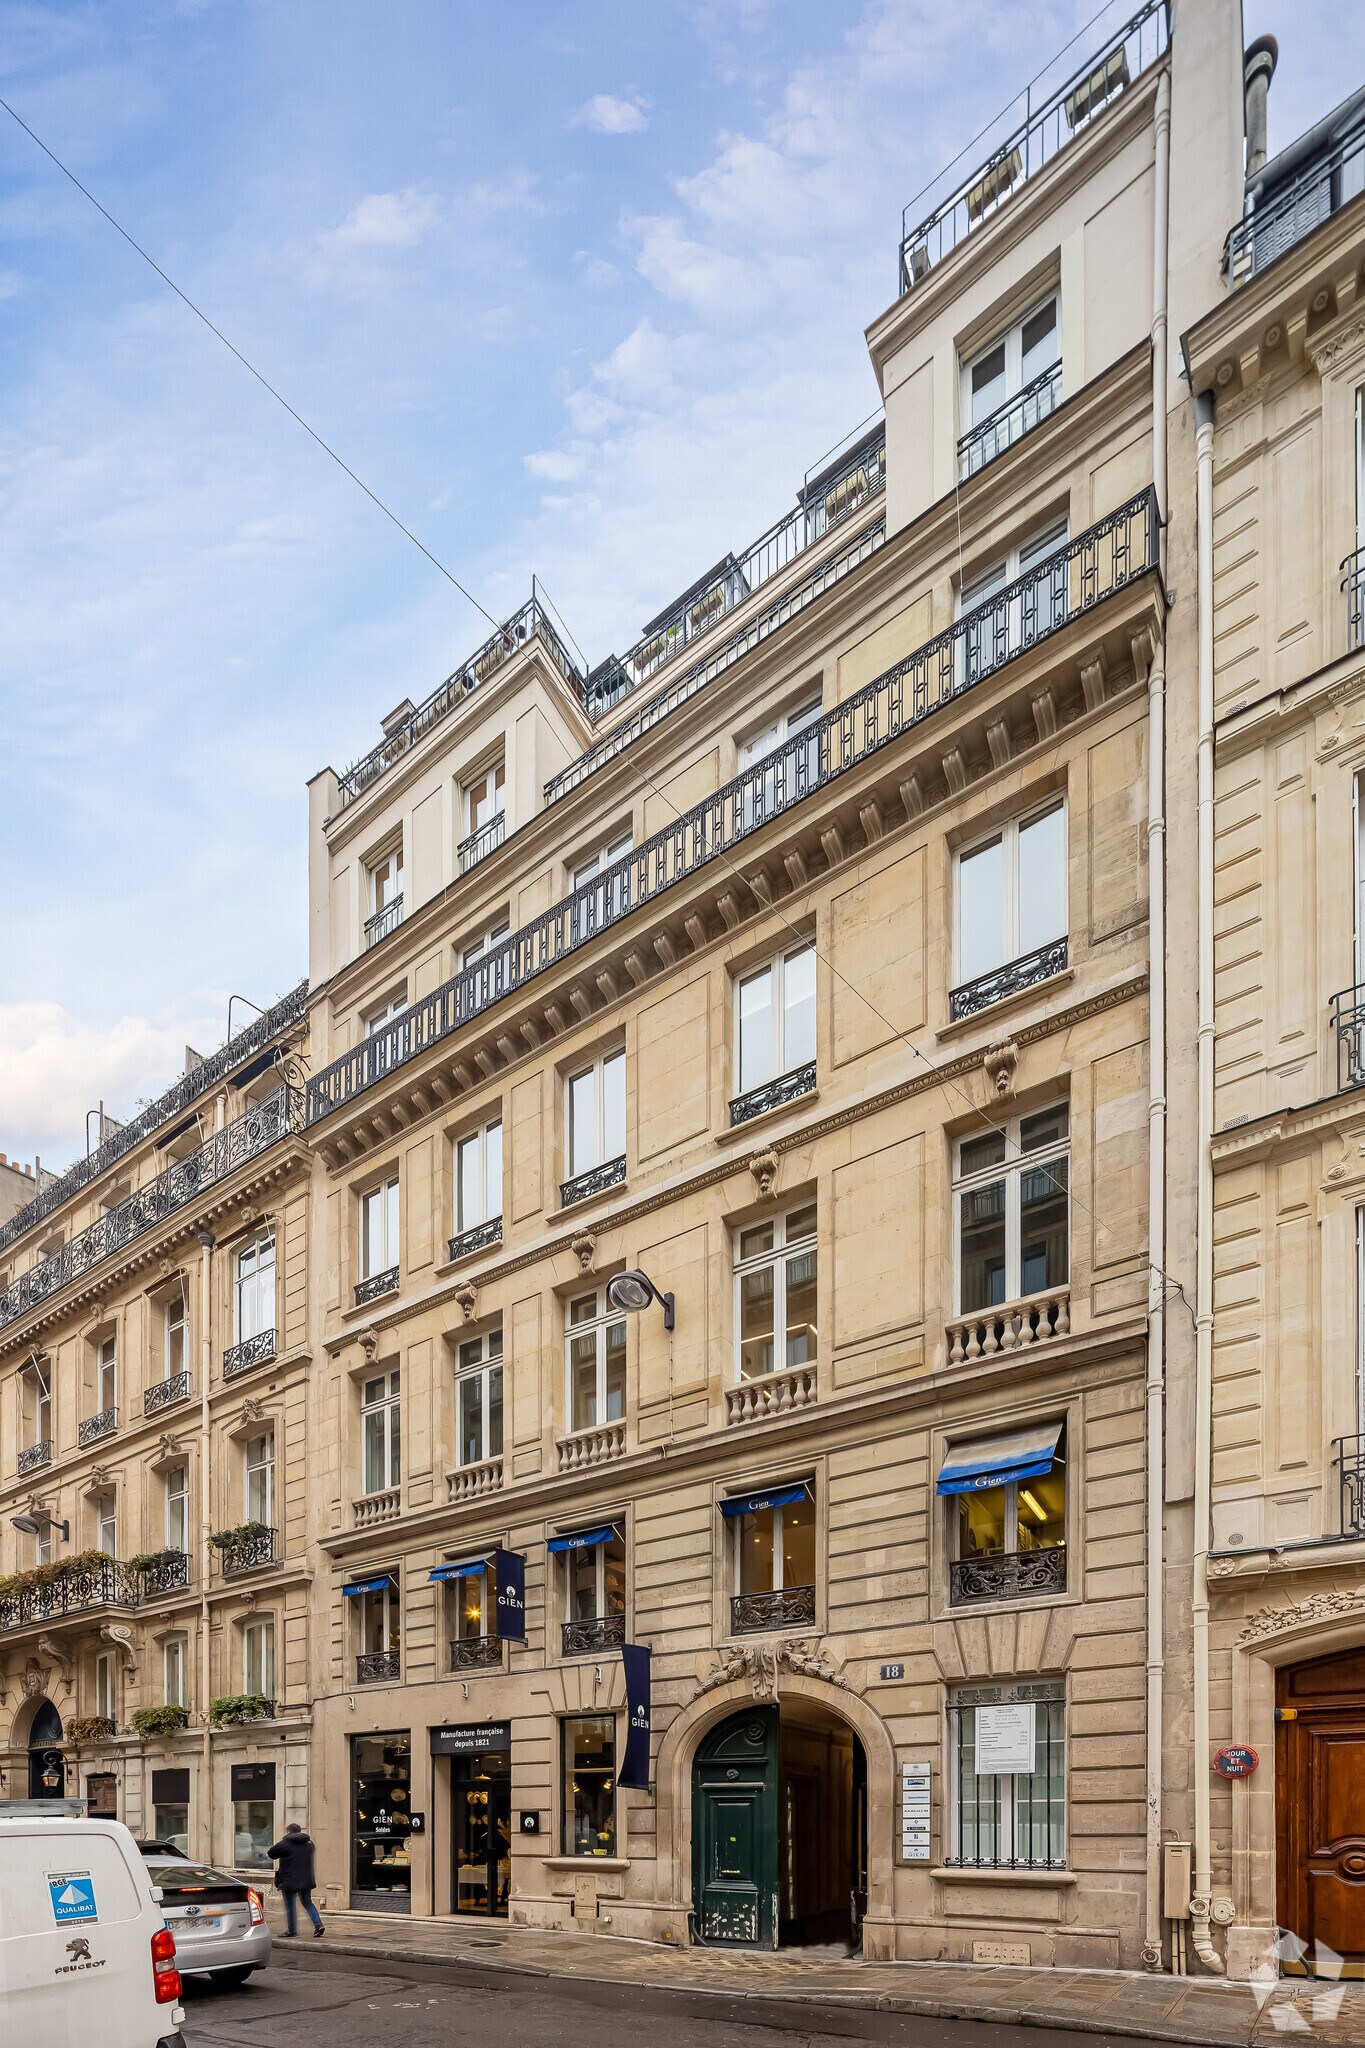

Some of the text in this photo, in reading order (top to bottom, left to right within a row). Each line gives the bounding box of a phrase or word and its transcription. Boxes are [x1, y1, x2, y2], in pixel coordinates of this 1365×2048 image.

[975, 1476, 1002, 1487] Gien
[749, 1499, 769, 1510] Gien
[498, 1596, 523, 1609] GIEN
[886, 1665, 899, 1678] 18
[631, 1717, 649, 1729] GIEN
[440, 1727, 504, 1739] Manufacture française
[454, 1738, 490, 1748] depuis 1821
[372, 1816, 393, 1824] GIEN
[52, 1878, 68, 1888] RGE
[56, 1904, 94, 1914] QUALIBAT
[55, 1959, 107, 1975] PEUGEOT
